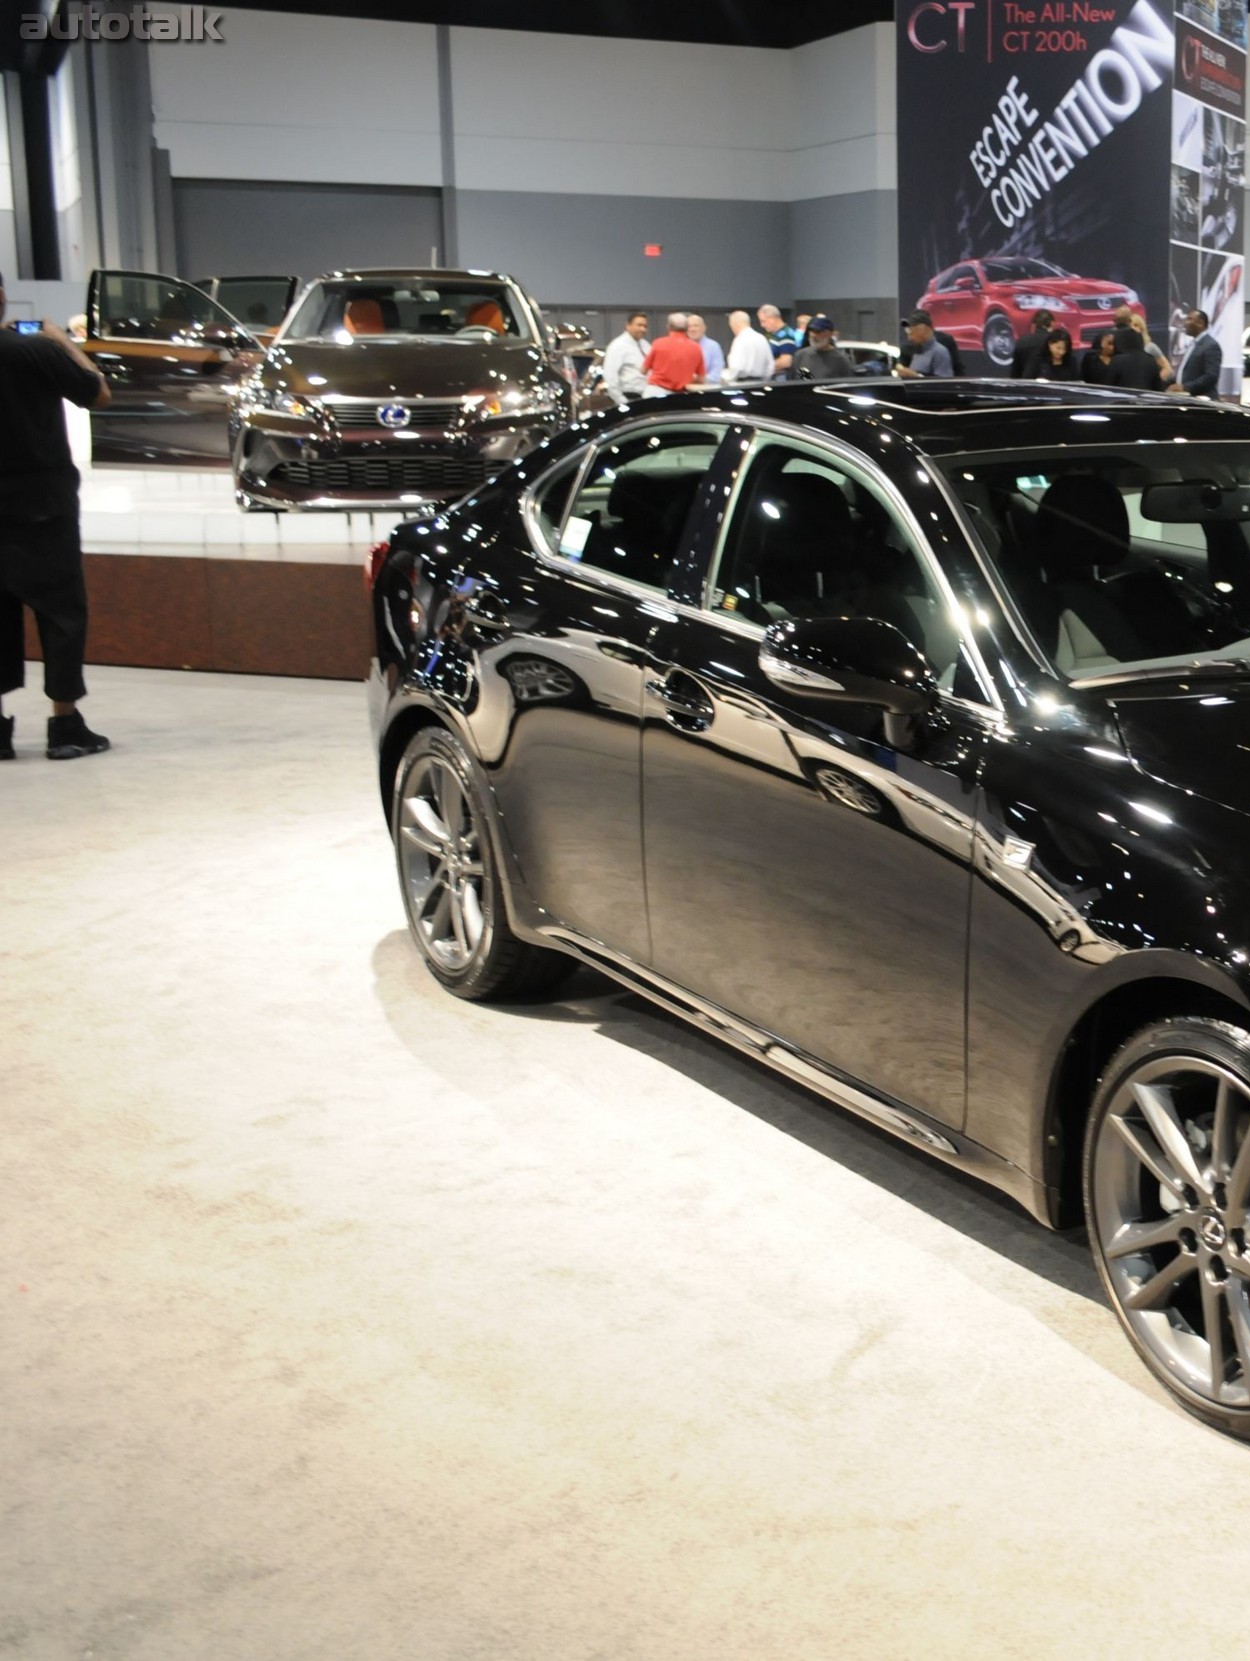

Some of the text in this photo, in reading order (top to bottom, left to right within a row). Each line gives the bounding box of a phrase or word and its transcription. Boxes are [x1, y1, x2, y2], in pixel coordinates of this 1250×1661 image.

[908, 2, 976, 53] CT
[1003, 3, 1116, 23] The All-New
[1002, 31, 1087, 52] CT 200h
[969, 75, 1039, 188] ESCAPE
[990, 0, 1175, 228] CONVENTION
